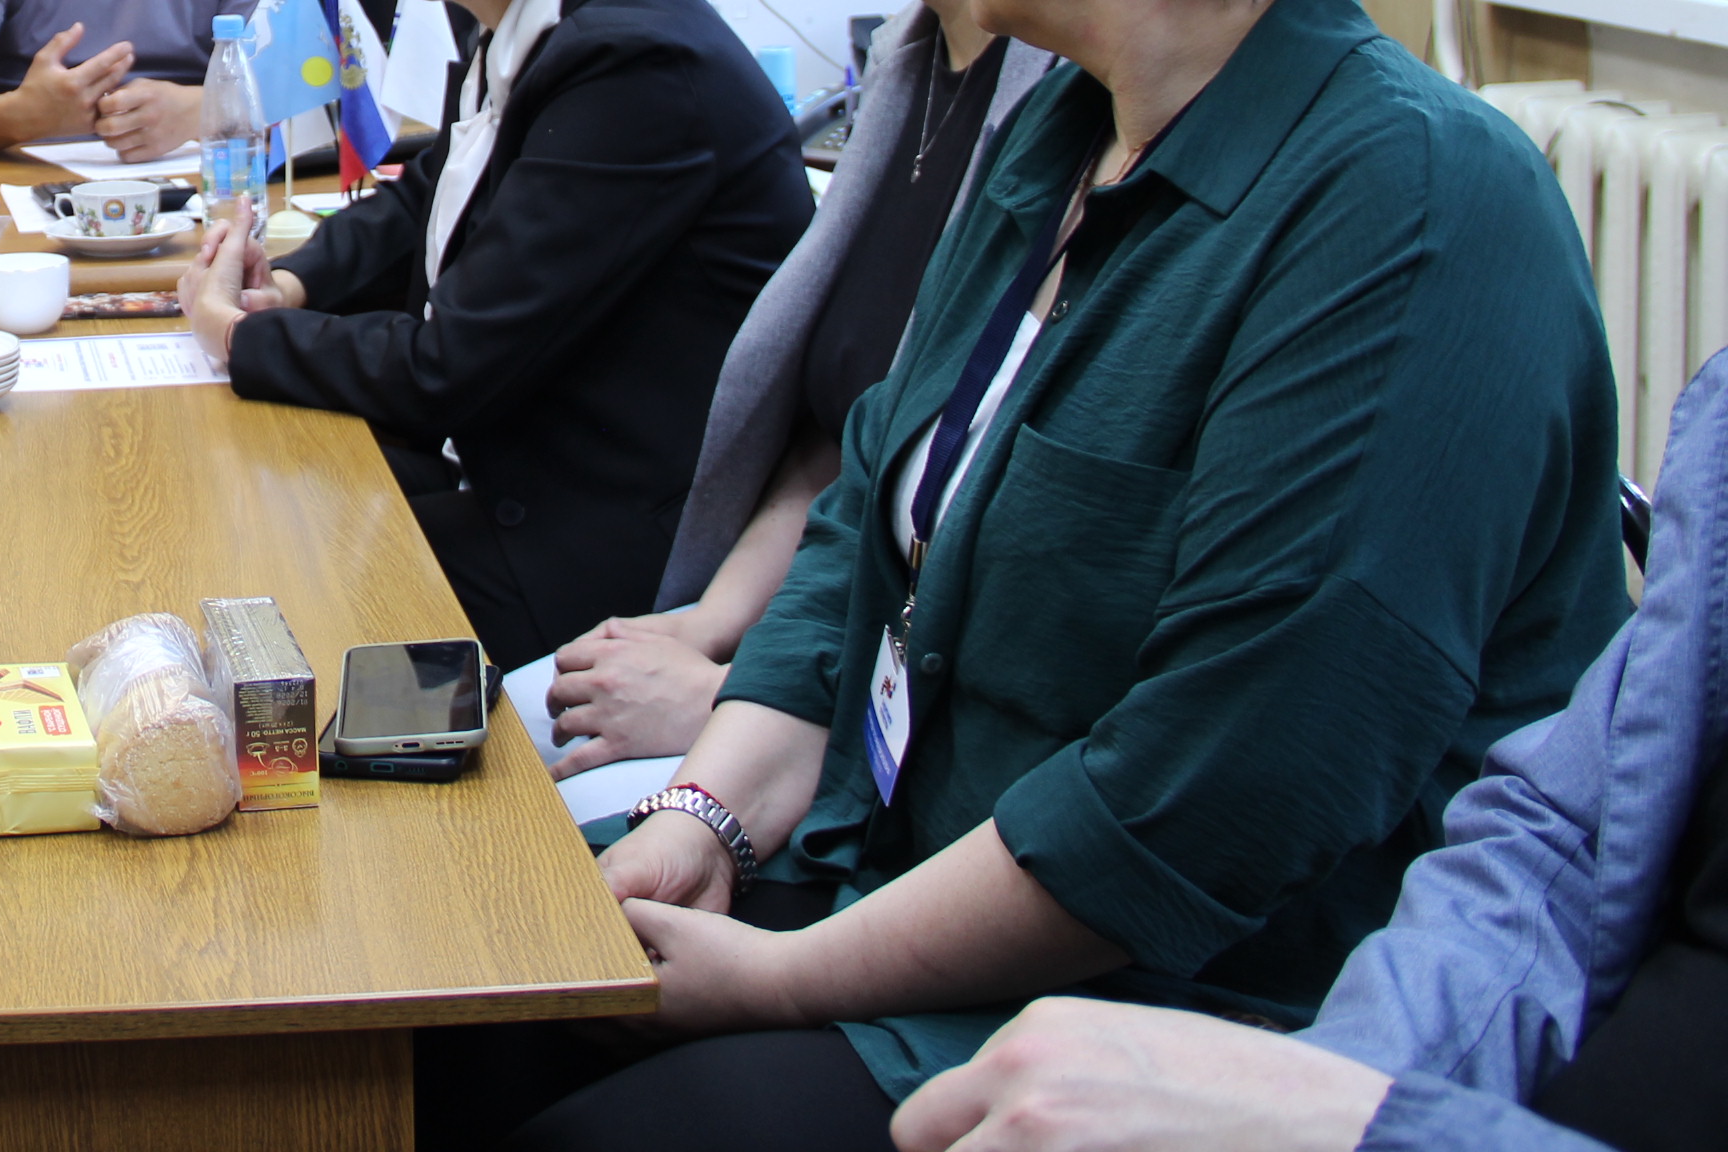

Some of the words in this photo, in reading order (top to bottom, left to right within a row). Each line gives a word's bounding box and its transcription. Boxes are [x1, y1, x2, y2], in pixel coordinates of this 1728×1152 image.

[13, 709, 37, 734] ВАФЛИ
[250, 730, 261, 738] 50
[242, 789, 315, 803] ВЫСОКОГОРНЫЙ
